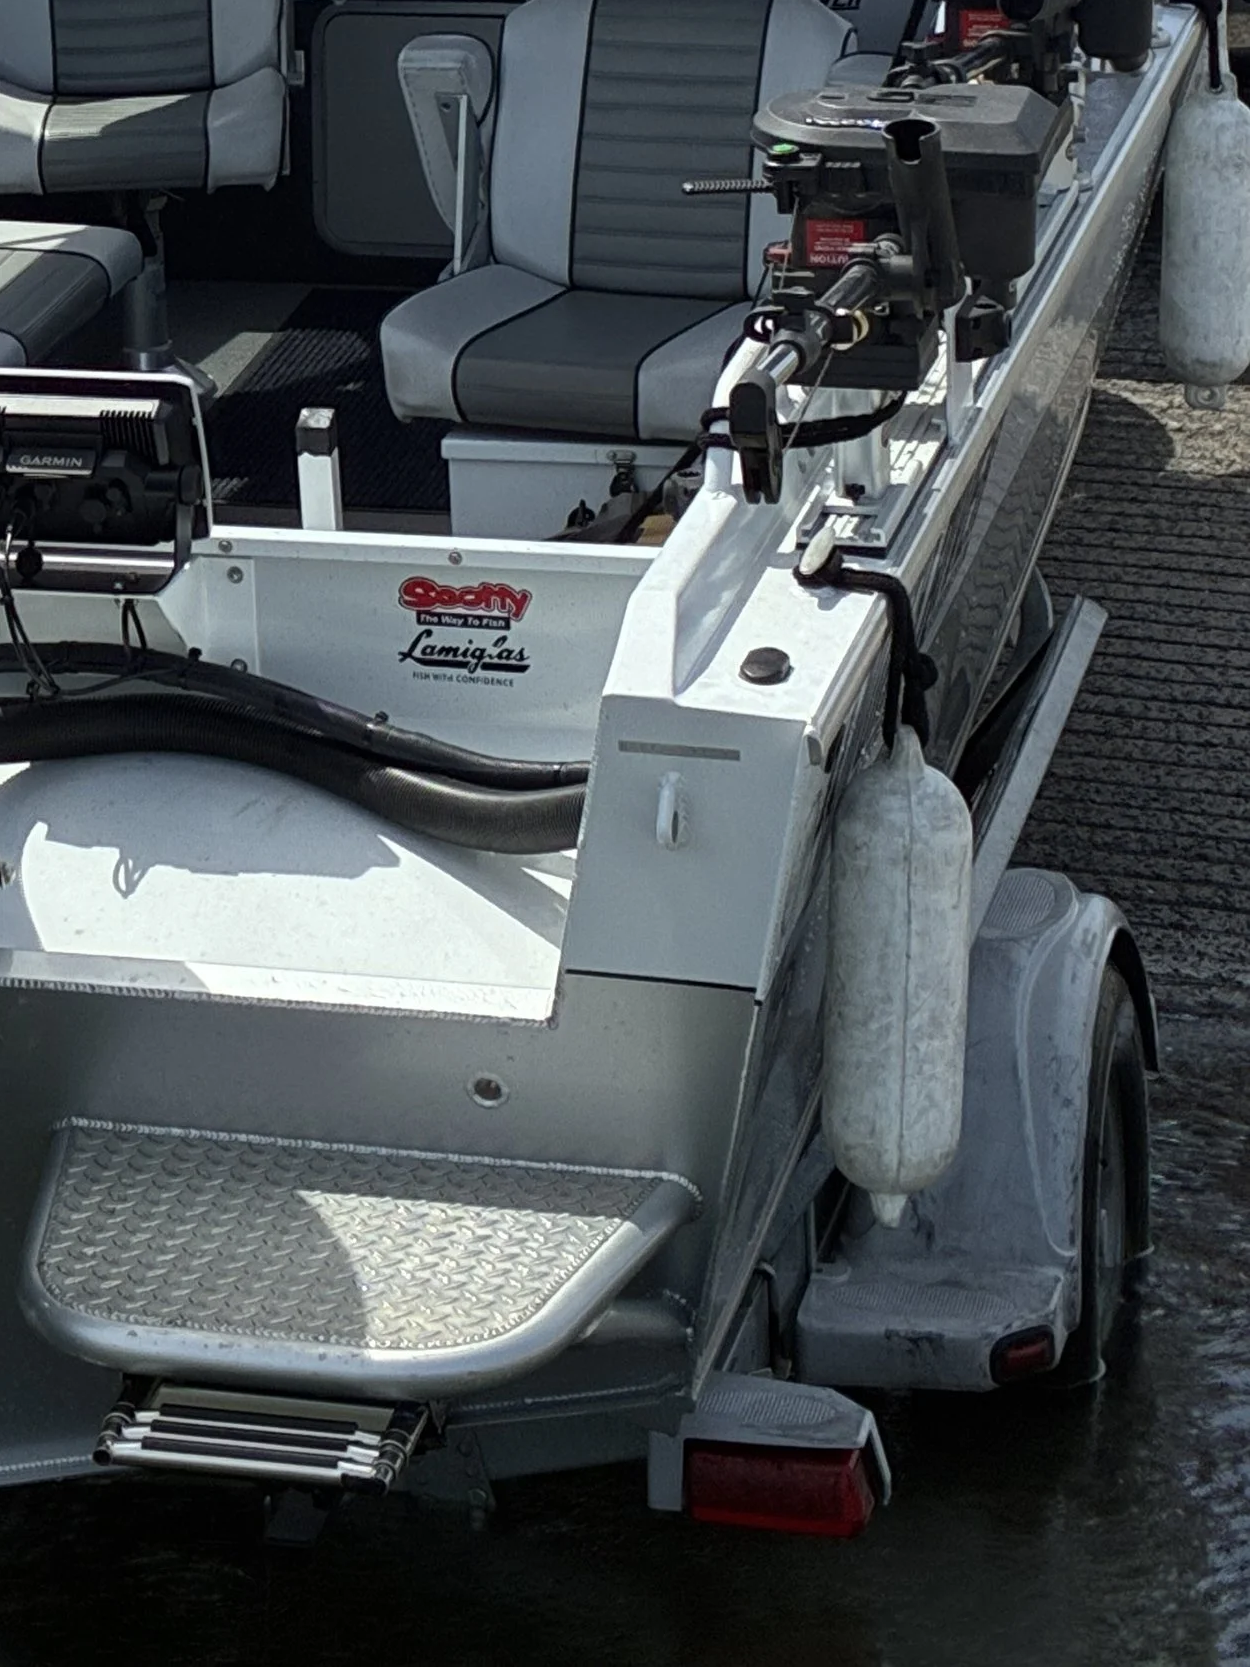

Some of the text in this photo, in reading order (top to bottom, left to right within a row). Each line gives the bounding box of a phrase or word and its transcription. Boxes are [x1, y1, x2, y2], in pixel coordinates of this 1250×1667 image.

[19, 454, 83, 468] GARMIN
[398, 577, 532, 622] Scotty
[419, 613, 506, 628] The Way To Fish
[412, 671, 431, 681] FISH
[455, 675, 515, 688] CONFIDENCE
